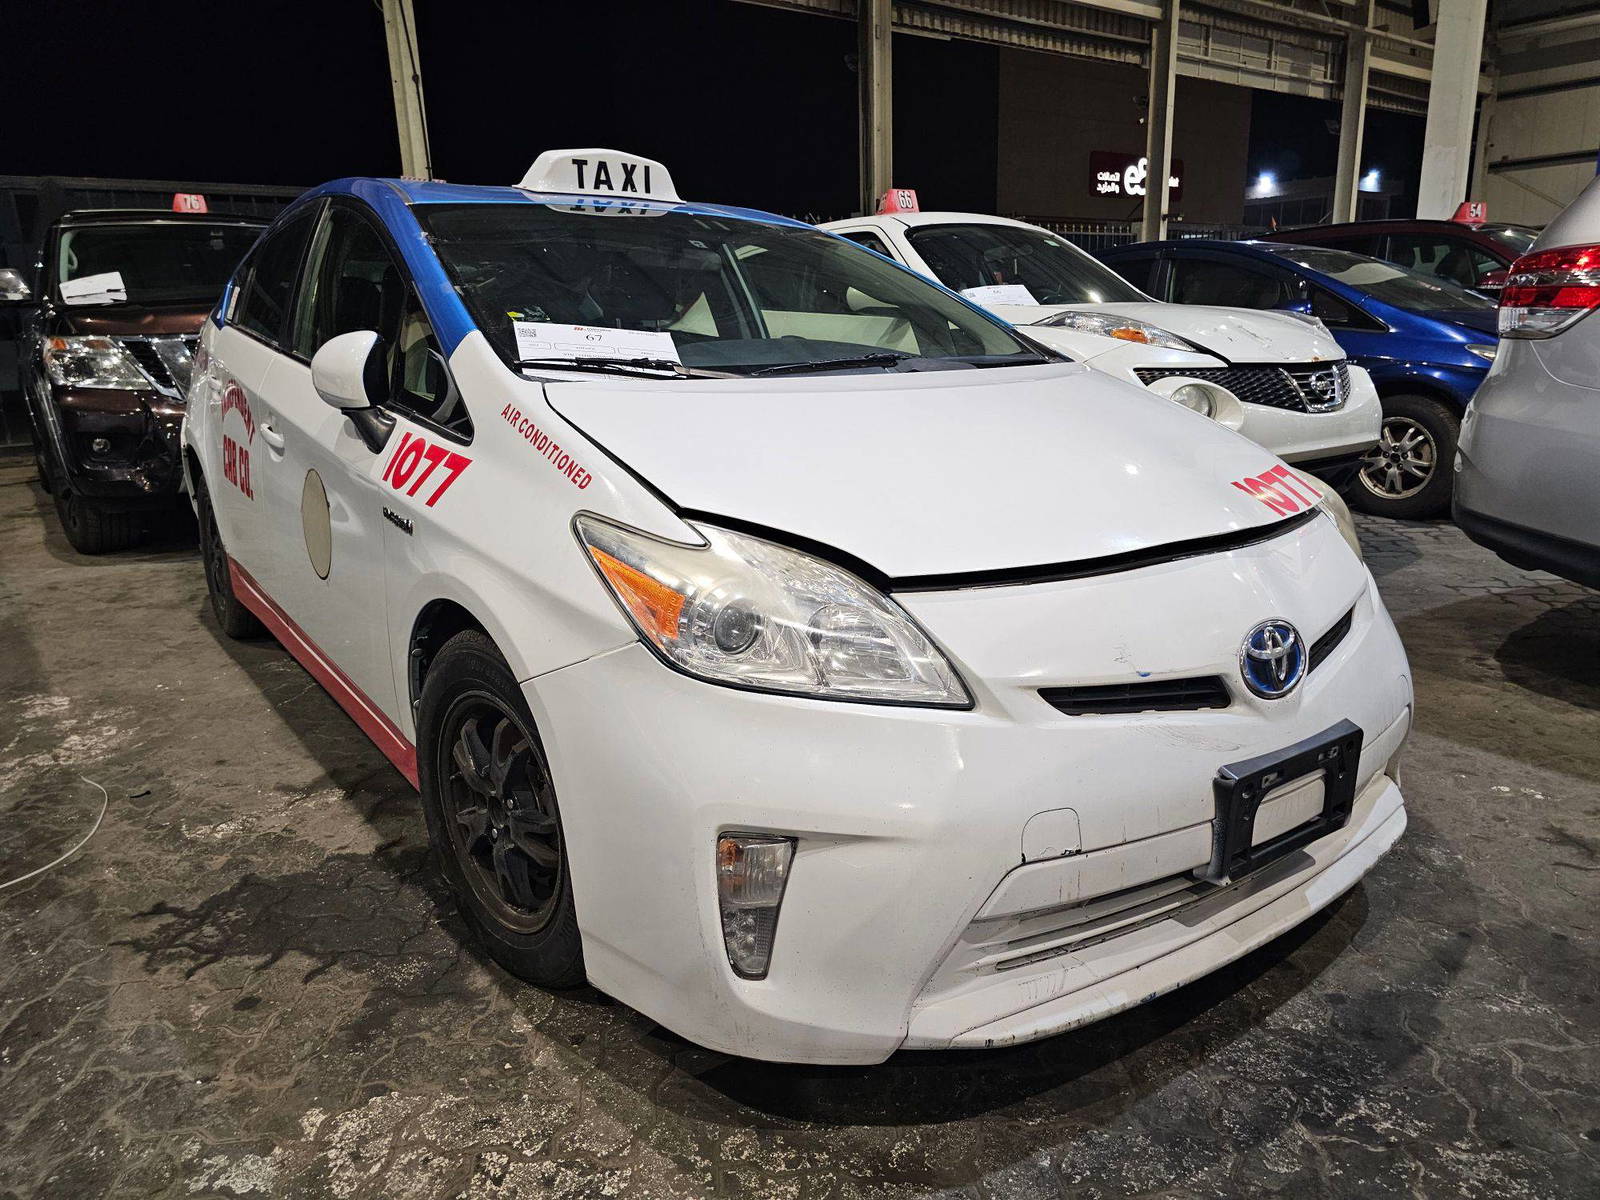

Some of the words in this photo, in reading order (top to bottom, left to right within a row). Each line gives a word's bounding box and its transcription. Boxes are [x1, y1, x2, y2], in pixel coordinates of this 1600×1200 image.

[571, 158, 651, 194] TAXI
[183, 195, 200, 210] 76
[898, 190, 913, 209] 66
[1470, 203, 1482, 218] 54
[586, 334, 603, 342] 67
[223, 434, 238, 487] CAB
[500, 402, 522, 428] AIR
[518, 420, 593, 490] CONDITIONED
[382, 431, 473, 508] 1077
[1230, 463, 1324, 517] 1077
